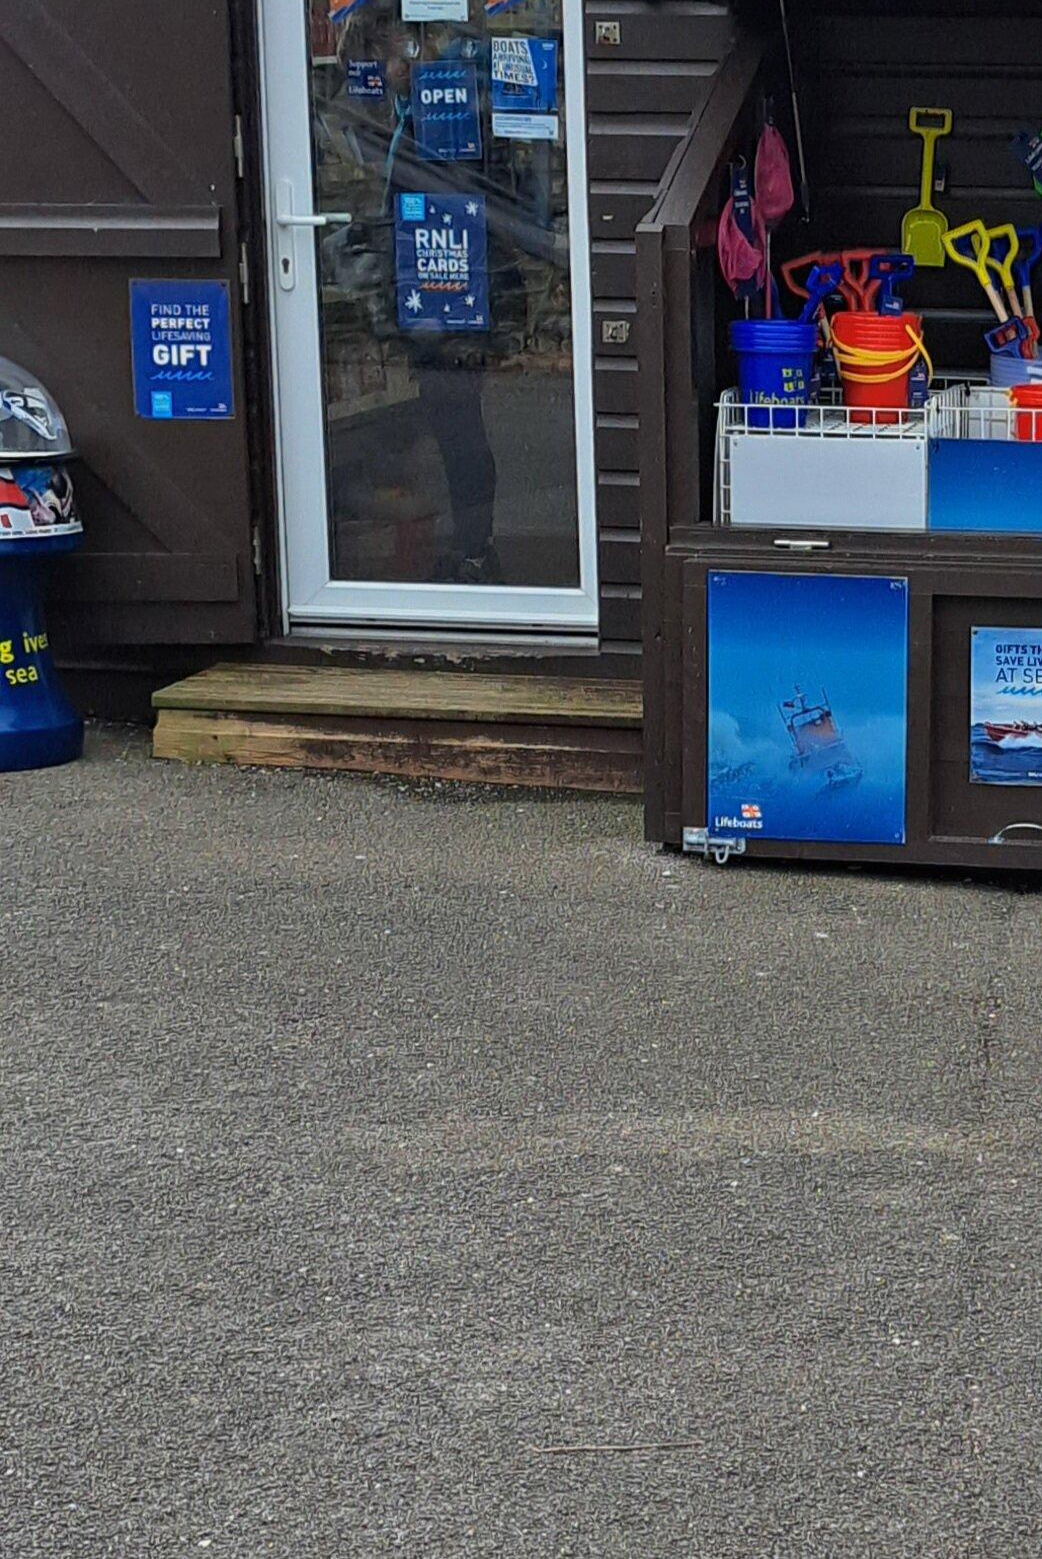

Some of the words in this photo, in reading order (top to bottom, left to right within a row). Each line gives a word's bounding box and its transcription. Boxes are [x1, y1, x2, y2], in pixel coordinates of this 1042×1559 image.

[493, 40, 528, 54] BOATS
[420, 88, 468, 104] OPEN
[415, 228, 469, 250] RNLI
[416, 249, 469, 258] CHRISTMAS
[417, 259, 469, 273] CARDS
[151, 304, 181, 316] FIND
[184, 304, 210, 317] THE
[151, 318, 211, 329] PERFECT
[151, 331, 211, 342] LIFESAVING
[152, 344, 212, 366] GIFT
[995, 644, 1028, 655] GIFTS
[995, 655, 1024, 667] SAVE
[5, 665, 39, 685] sea
[995, 667, 1018, 683] AT
[715, 816, 763, 829] Lifeboats
